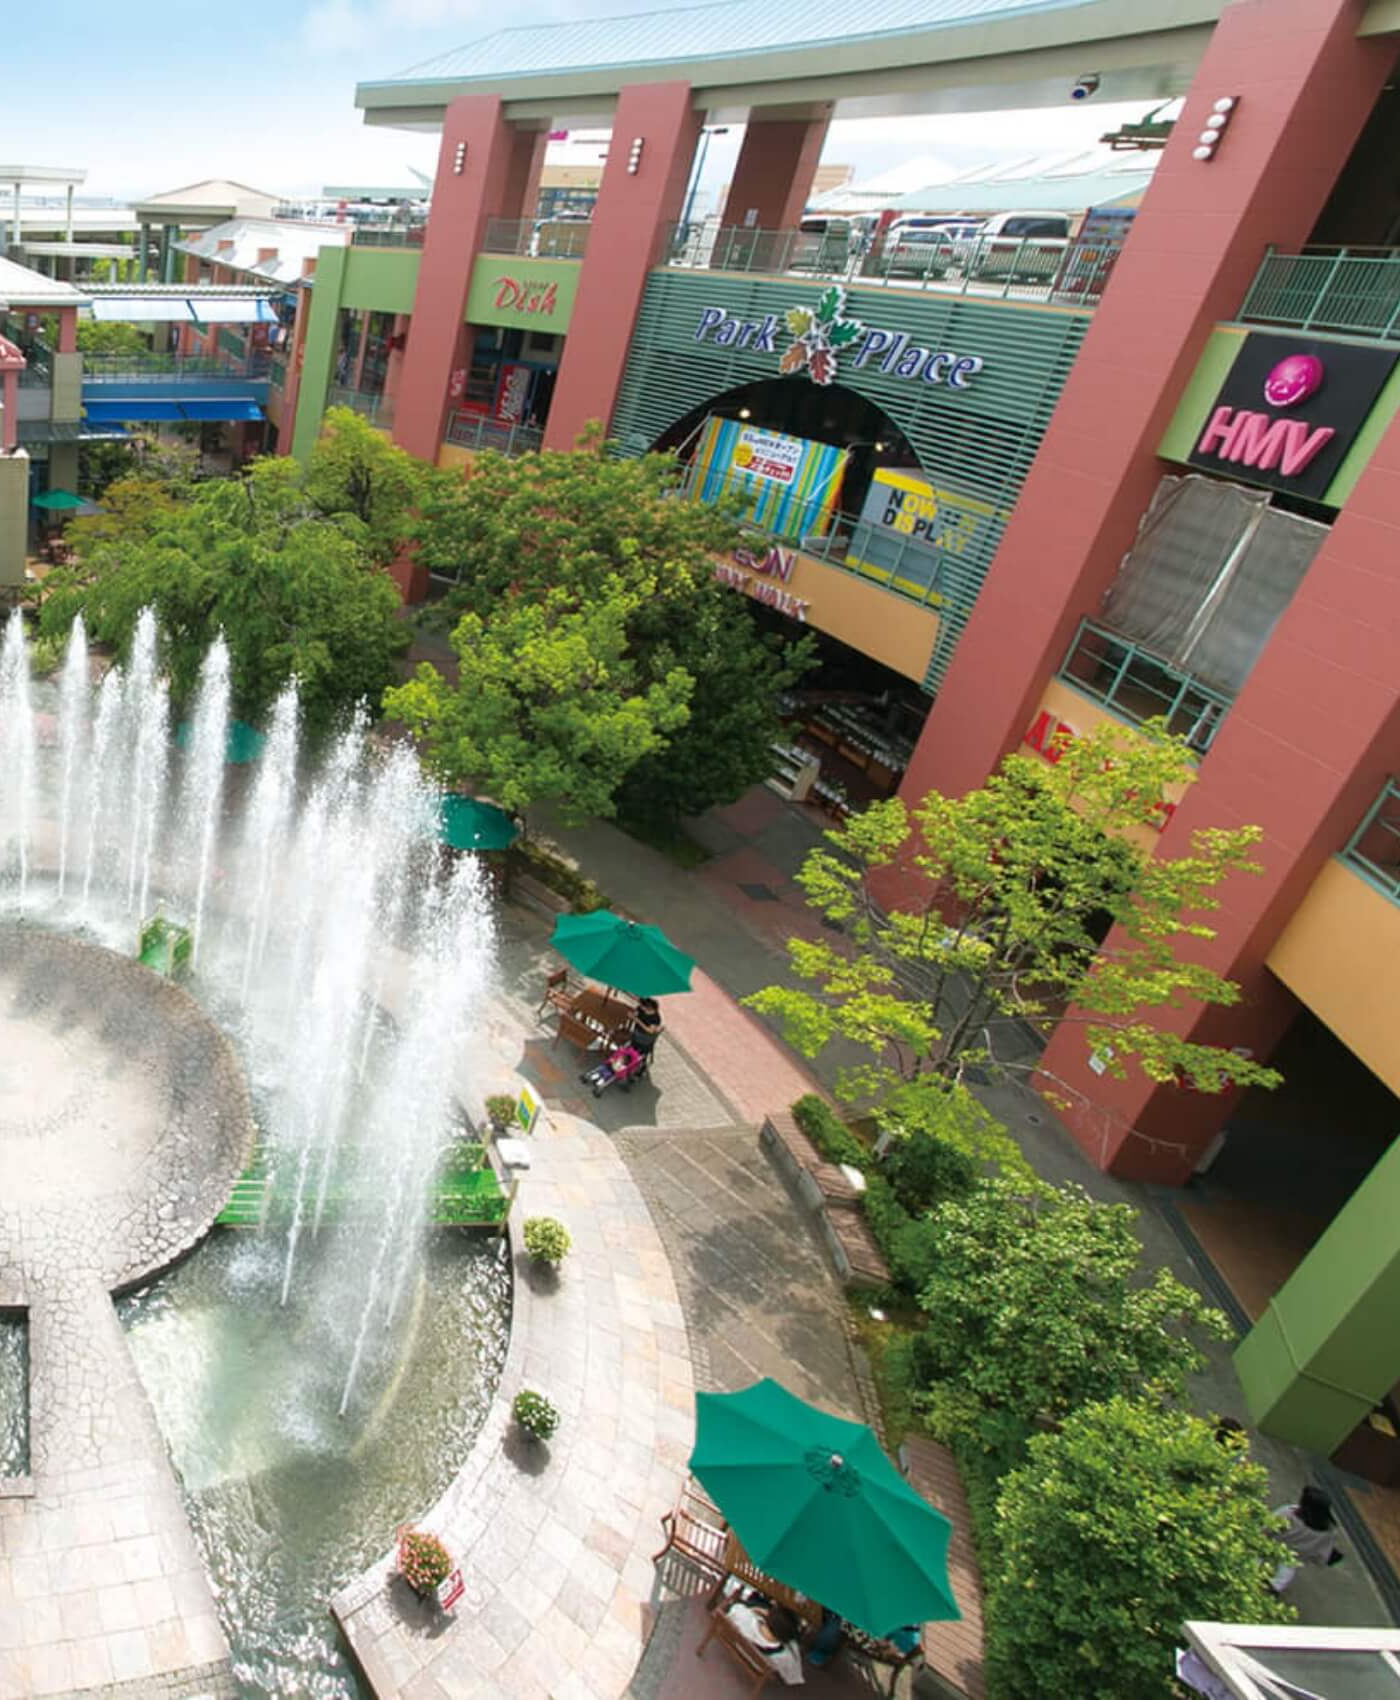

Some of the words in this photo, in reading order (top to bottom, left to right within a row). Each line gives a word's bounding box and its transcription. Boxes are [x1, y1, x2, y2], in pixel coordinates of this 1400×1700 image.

[695, 307, 781, 352] Park
[852, 326, 984, 389] Place
[1198, 405, 1336, 478] HMV
